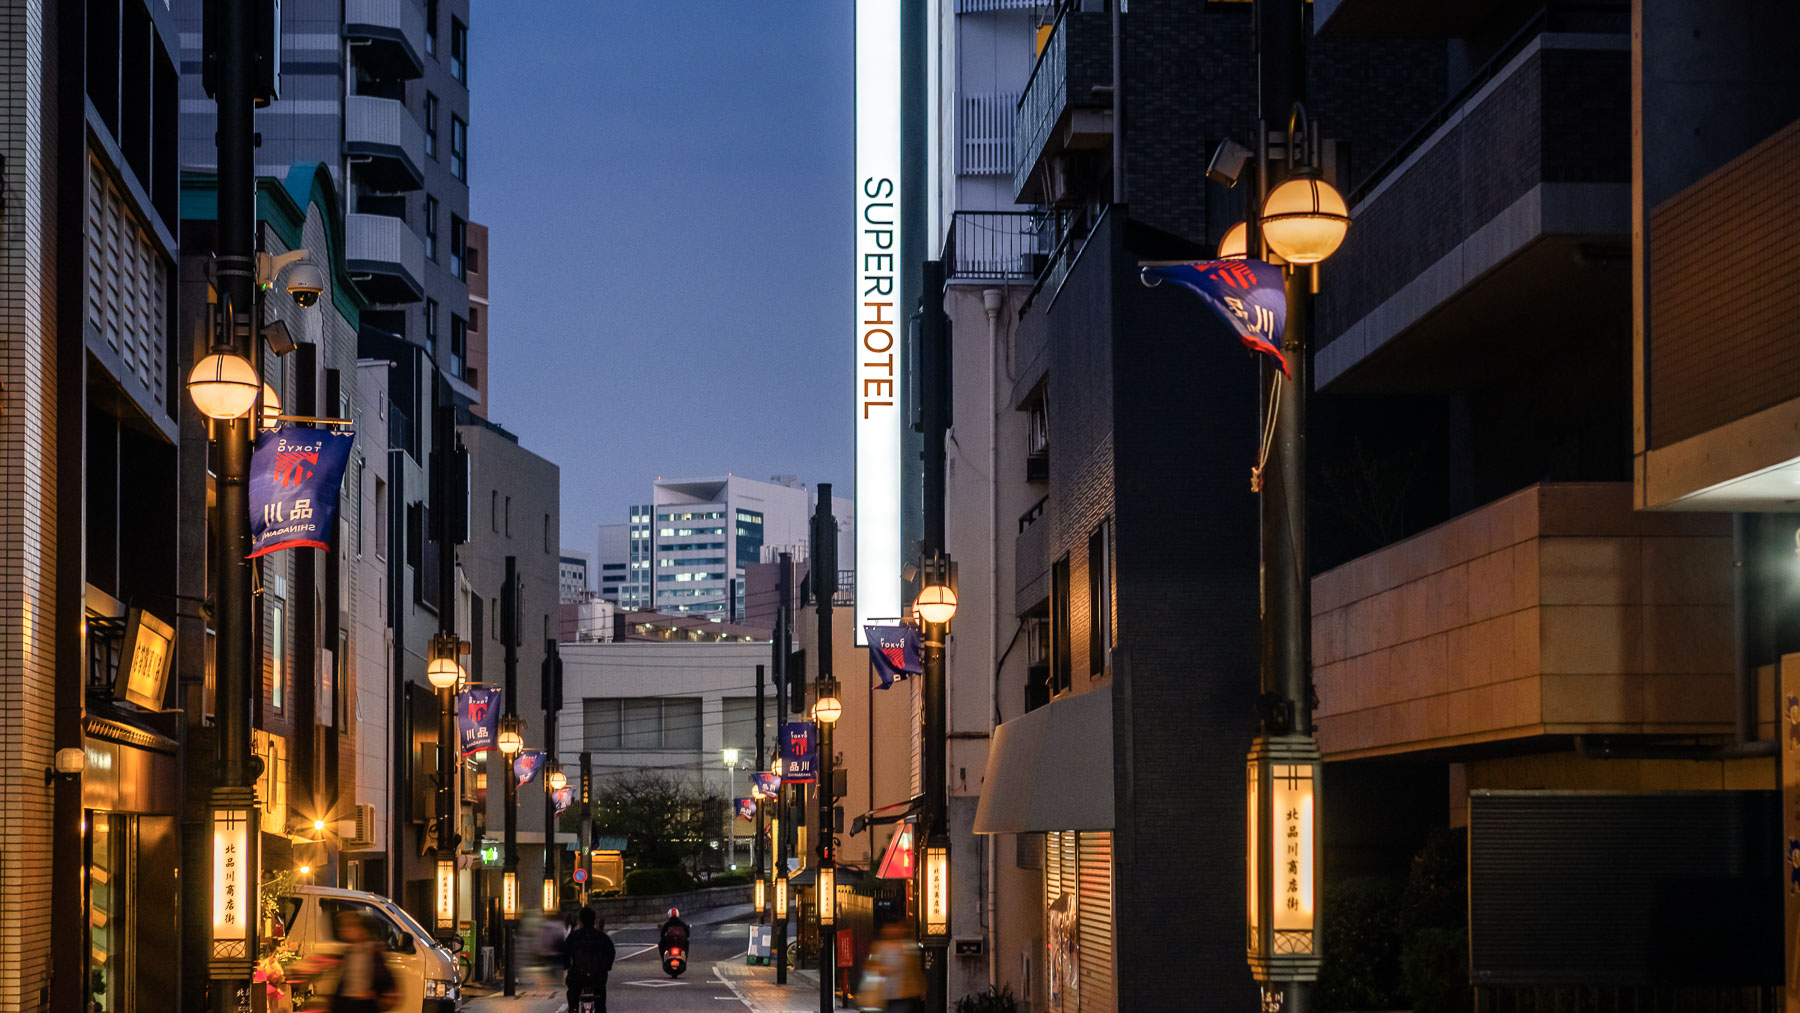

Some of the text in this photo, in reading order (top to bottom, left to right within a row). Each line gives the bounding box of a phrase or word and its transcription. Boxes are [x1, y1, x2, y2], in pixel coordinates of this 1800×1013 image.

[789, 761, 810, 771] 品川
[224, 843, 236, 925] 北品川商店街
[1286, 807, 1299, 912] 北品川商店街
